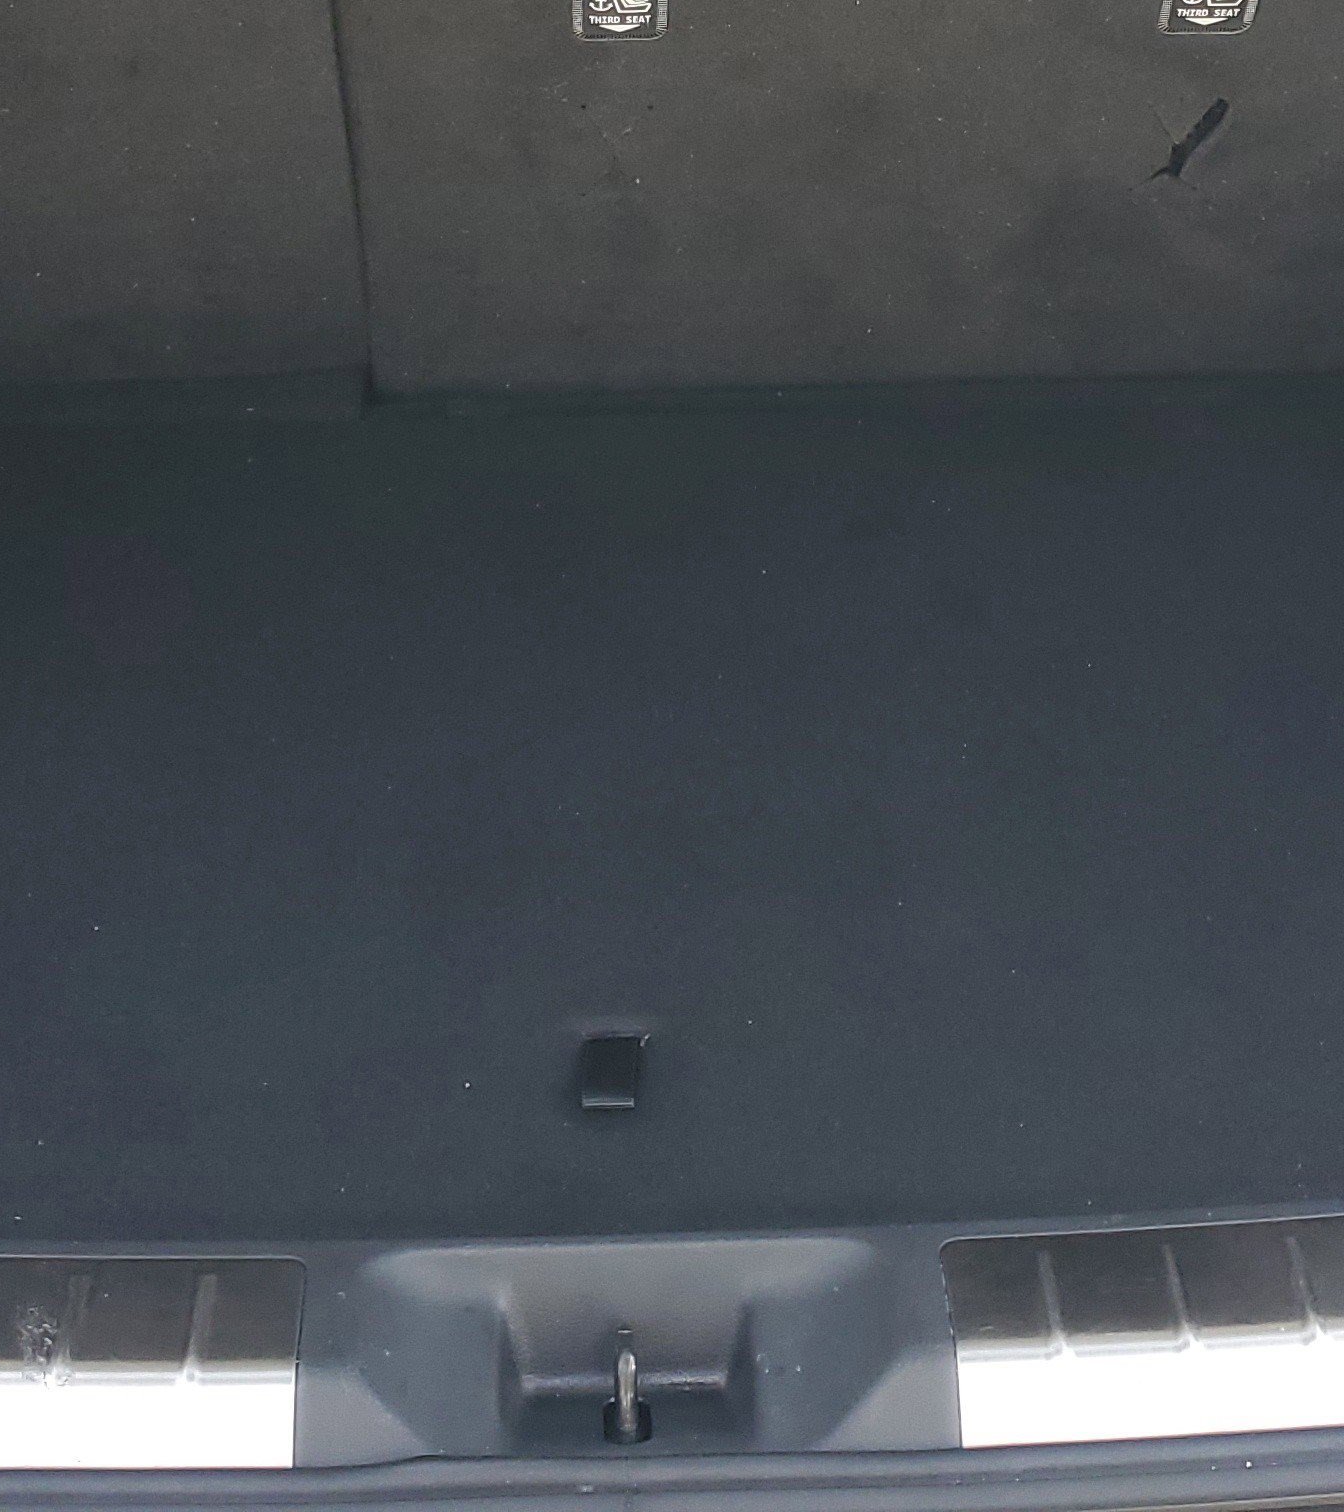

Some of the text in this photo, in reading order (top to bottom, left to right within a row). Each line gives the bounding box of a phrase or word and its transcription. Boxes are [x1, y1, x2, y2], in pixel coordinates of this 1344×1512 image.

[1176, 8, 1241, 17] THIRD SEAT
[588, 15, 652, 24] THIRD SEAT
